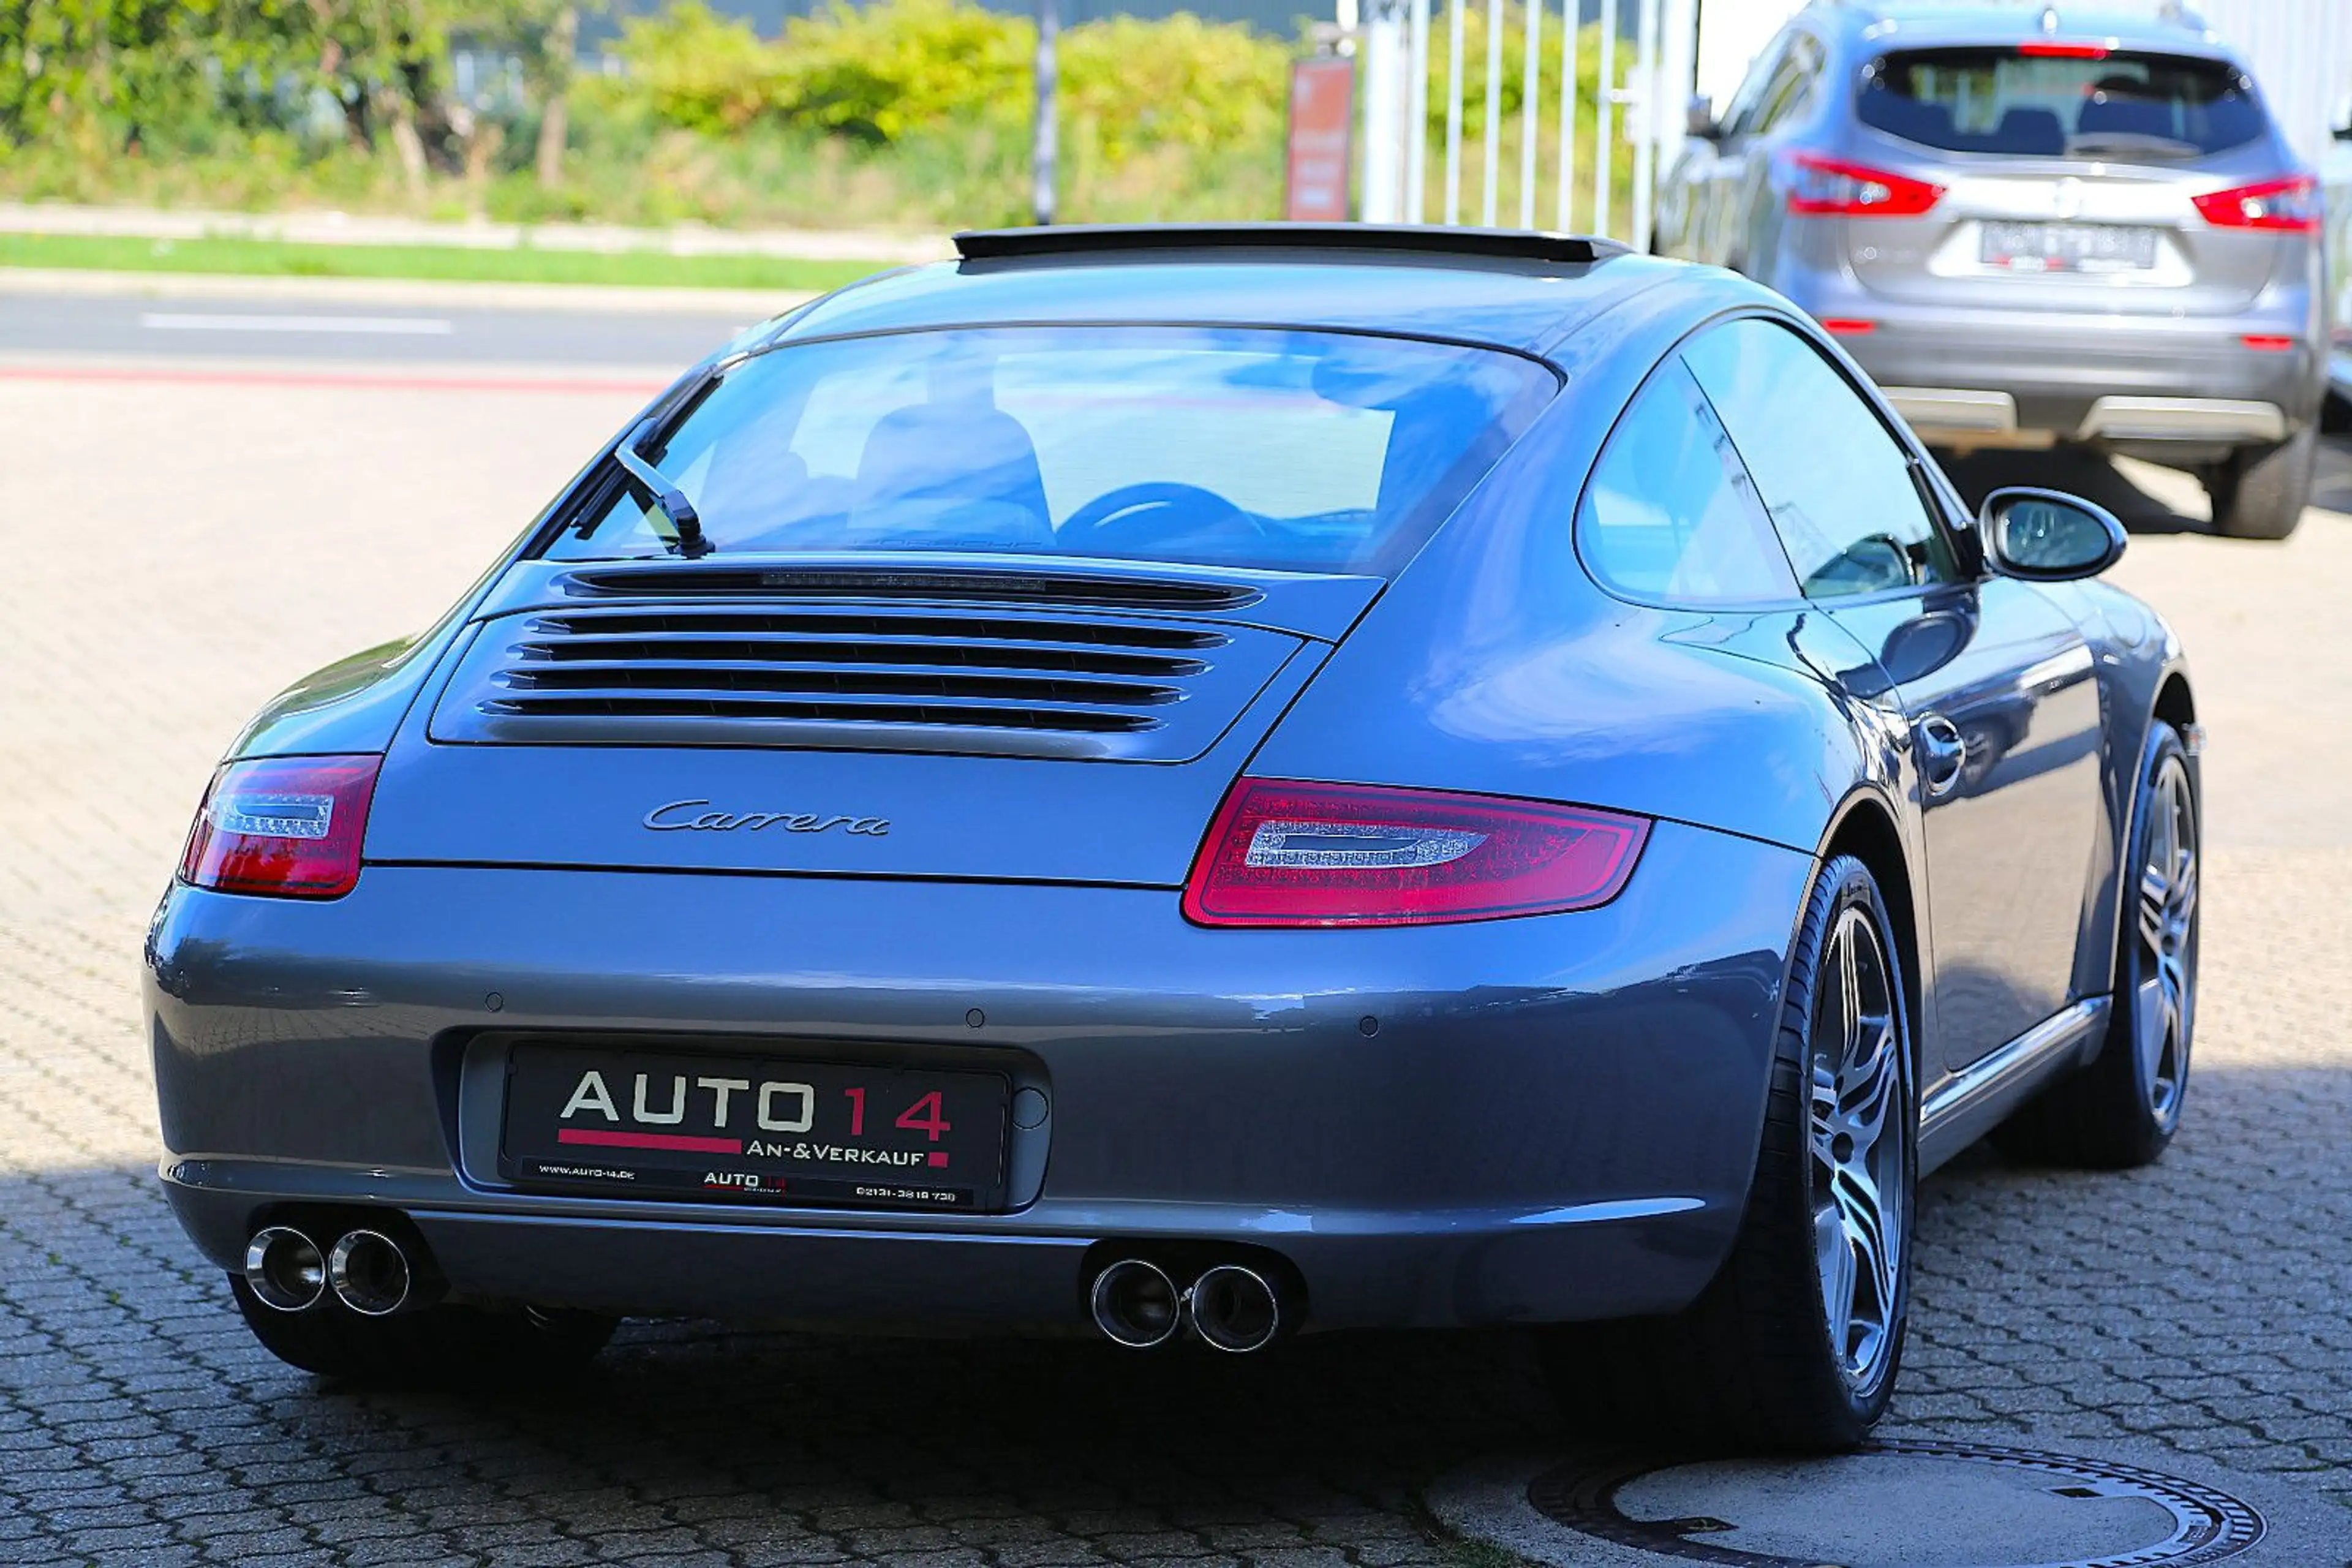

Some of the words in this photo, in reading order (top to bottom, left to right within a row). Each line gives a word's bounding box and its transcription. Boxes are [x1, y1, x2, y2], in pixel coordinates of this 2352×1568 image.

[643, 798, 891, 835] Carrera
[560, 1071, 814, 1133] AUTO
[704, 1172, 759, 1187] AUTO
